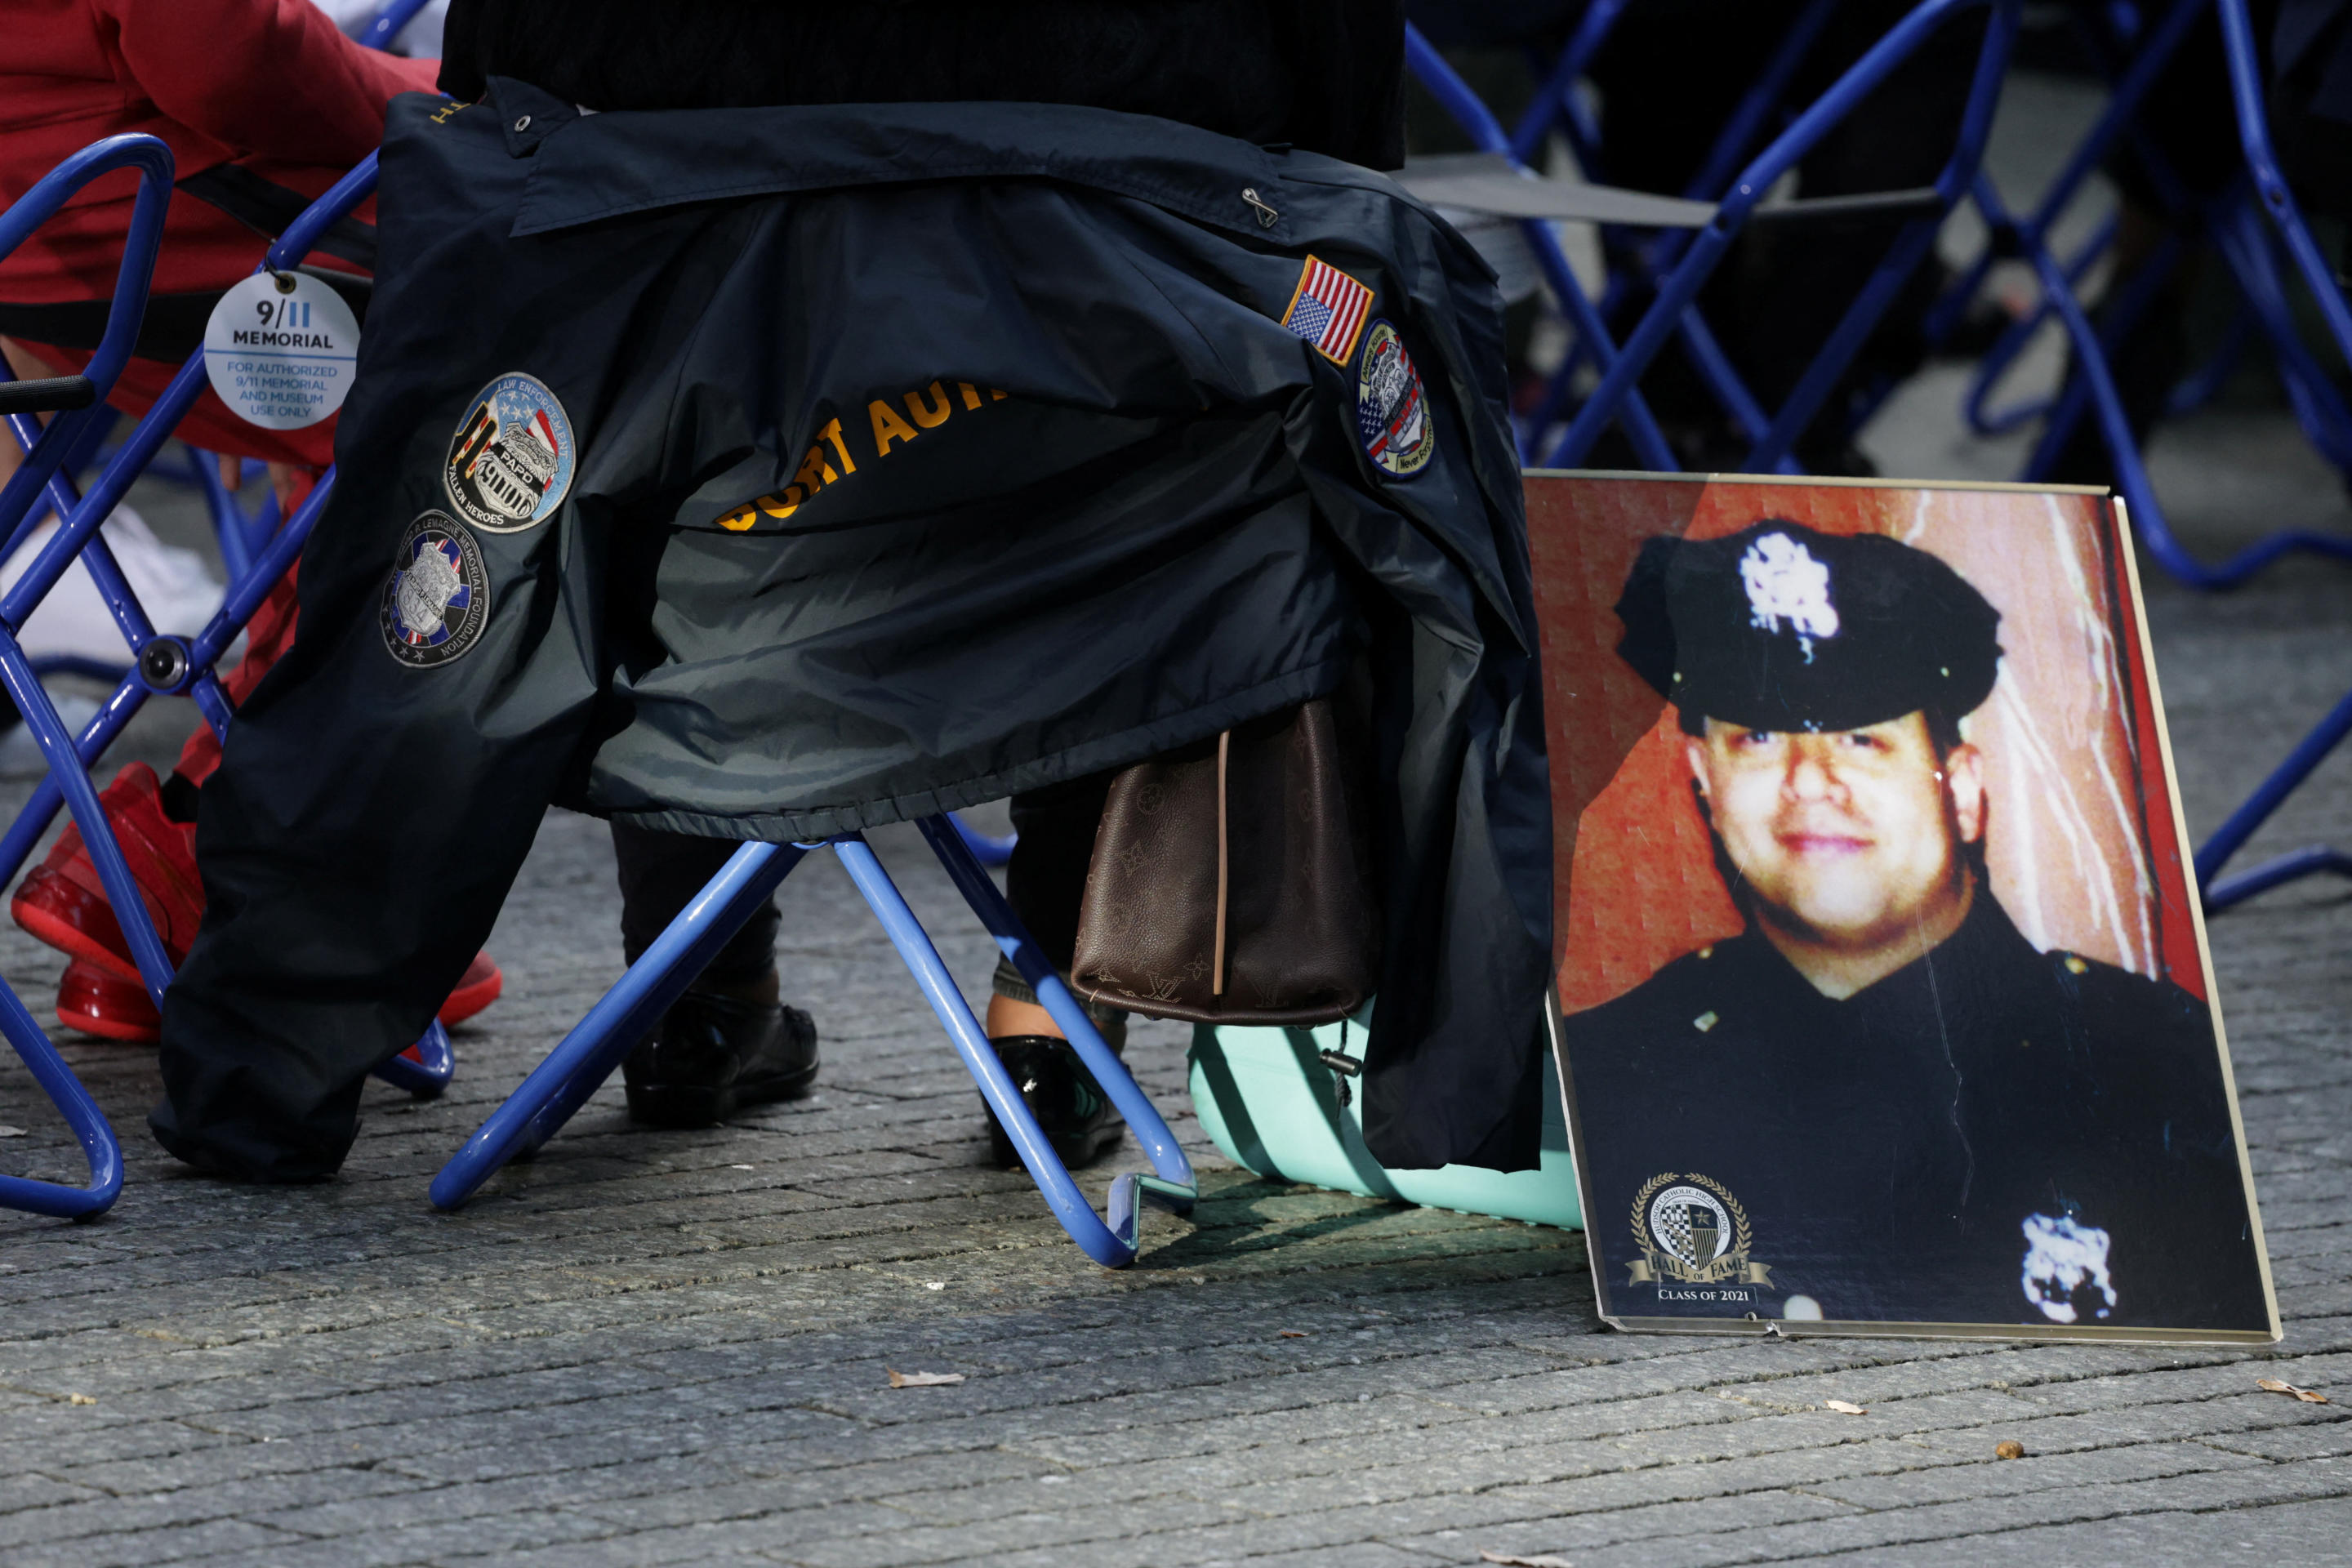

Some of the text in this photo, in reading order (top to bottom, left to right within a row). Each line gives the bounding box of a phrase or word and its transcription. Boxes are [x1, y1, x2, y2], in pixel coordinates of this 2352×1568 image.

[256, 298, 310, 329] 9/11
[233, 330, 334, 349] MEMORIAL
[227, 361, 338, 378] FOR AUTHORIZED
[235, 376, 328, 391] 9/11 MEMORIAL
[239, 390, 323, 404] AND MUSEUM
[251, 405, 312, 418] USE ONLY
[497, 379, 516, 392] LAW
[519, 381, 568, 460] ENFORCEMENT
[500, 451, 534, 483] PAPD
[1400, 455, 1419, 470] Never
[448, 466, 505, 525] FALLEN HEROES
[423, 519, 459, 537] LEMAGNE
[458, 533, 483, 593] MEMORIAL
[440, 596, 483, 657] FOUNDATION
[1653, 1188, 1730, 1235] HUDSON CATHOLIC HIGH SCHOOL
[1650, 1255, 1689, 1277] HALL
[1711, 1257, 1748, 1277] FAME
[1719, 1290, 1749, 1301] 2021
